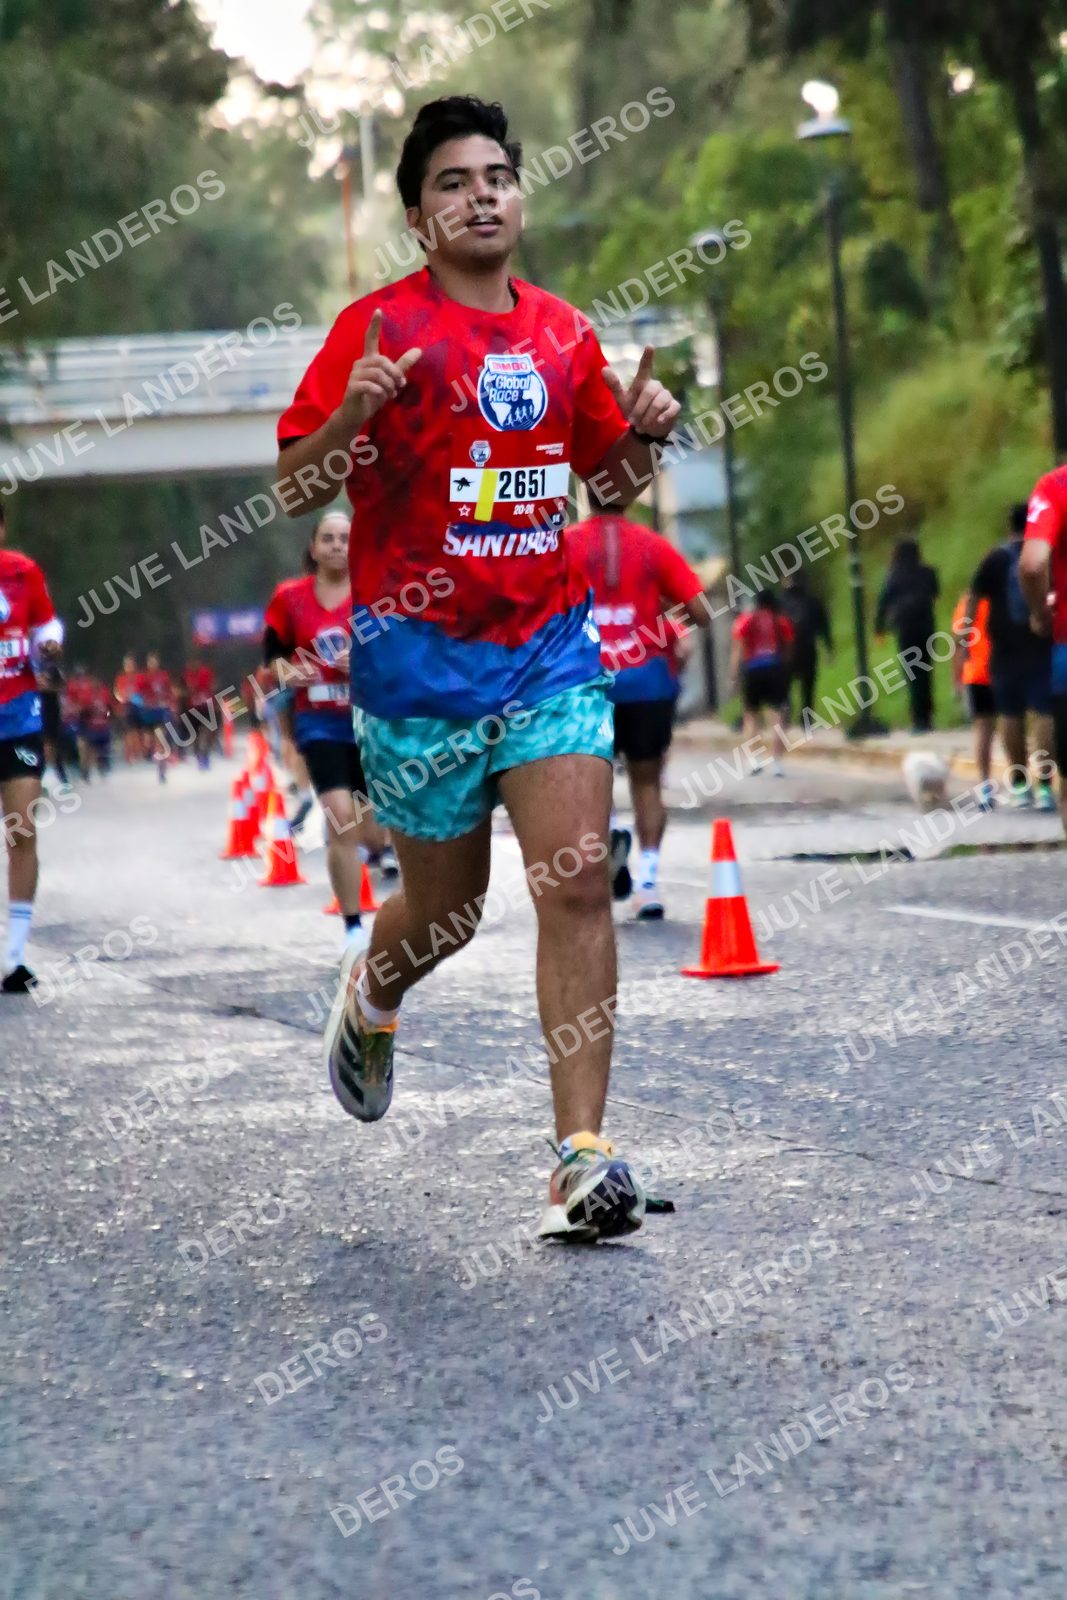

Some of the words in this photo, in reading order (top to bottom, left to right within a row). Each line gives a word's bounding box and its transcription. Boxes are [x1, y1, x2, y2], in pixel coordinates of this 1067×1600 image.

[495, 374, 531, 390] Global
[489, 388, 519, 402] Race
[499, 468, 546, 499] 2651
